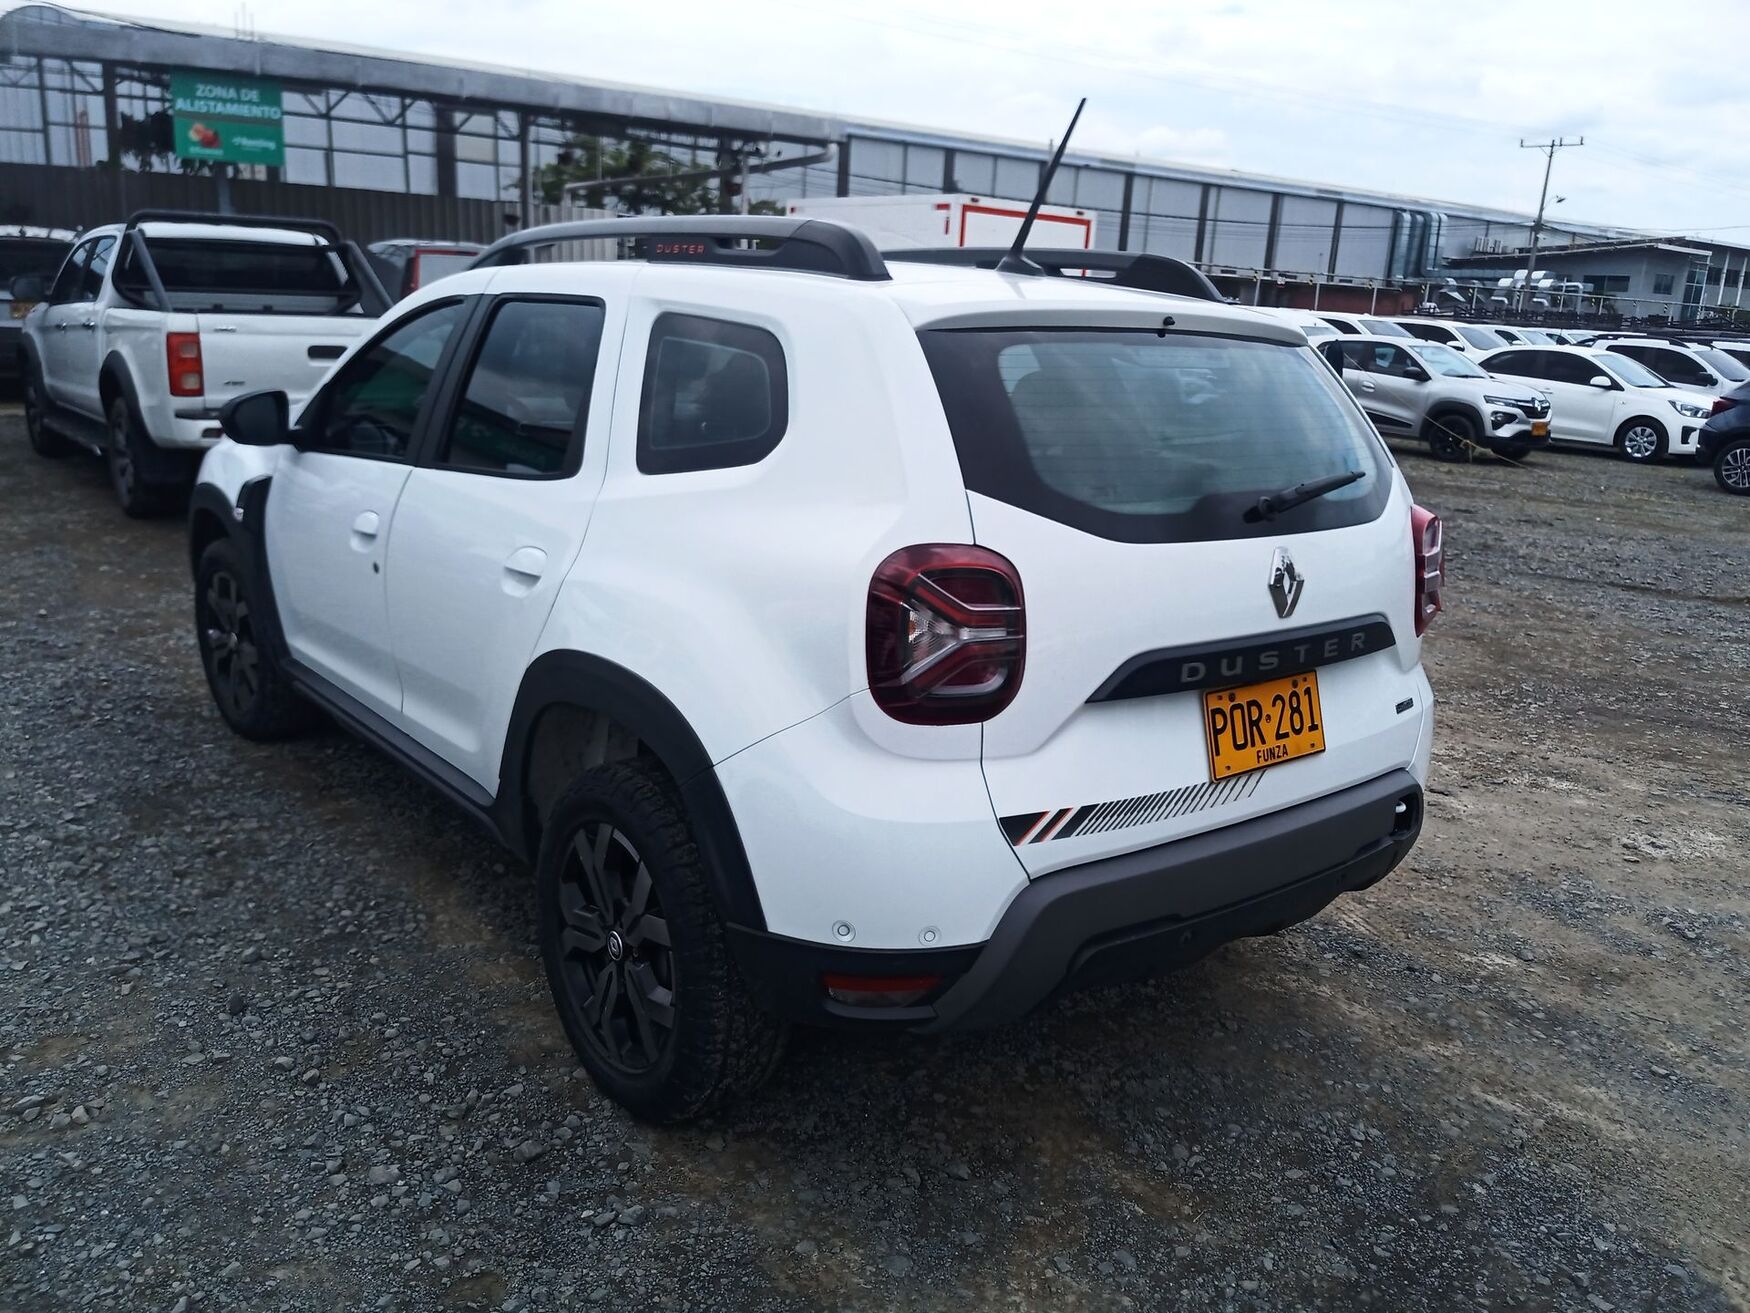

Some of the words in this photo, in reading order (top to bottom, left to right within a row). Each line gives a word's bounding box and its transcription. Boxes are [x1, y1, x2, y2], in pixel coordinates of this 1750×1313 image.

[195, 83, 237, 99] ZONA
[240, 88, 260, 102] DE
[175, 98, 281, 119] ALISTAMIENTO
[656, 244, 704, 254] DUSTER
[1180, 632, 1366, 683] DUSTER
[1256, 743, 1288, 764] FUNZA
